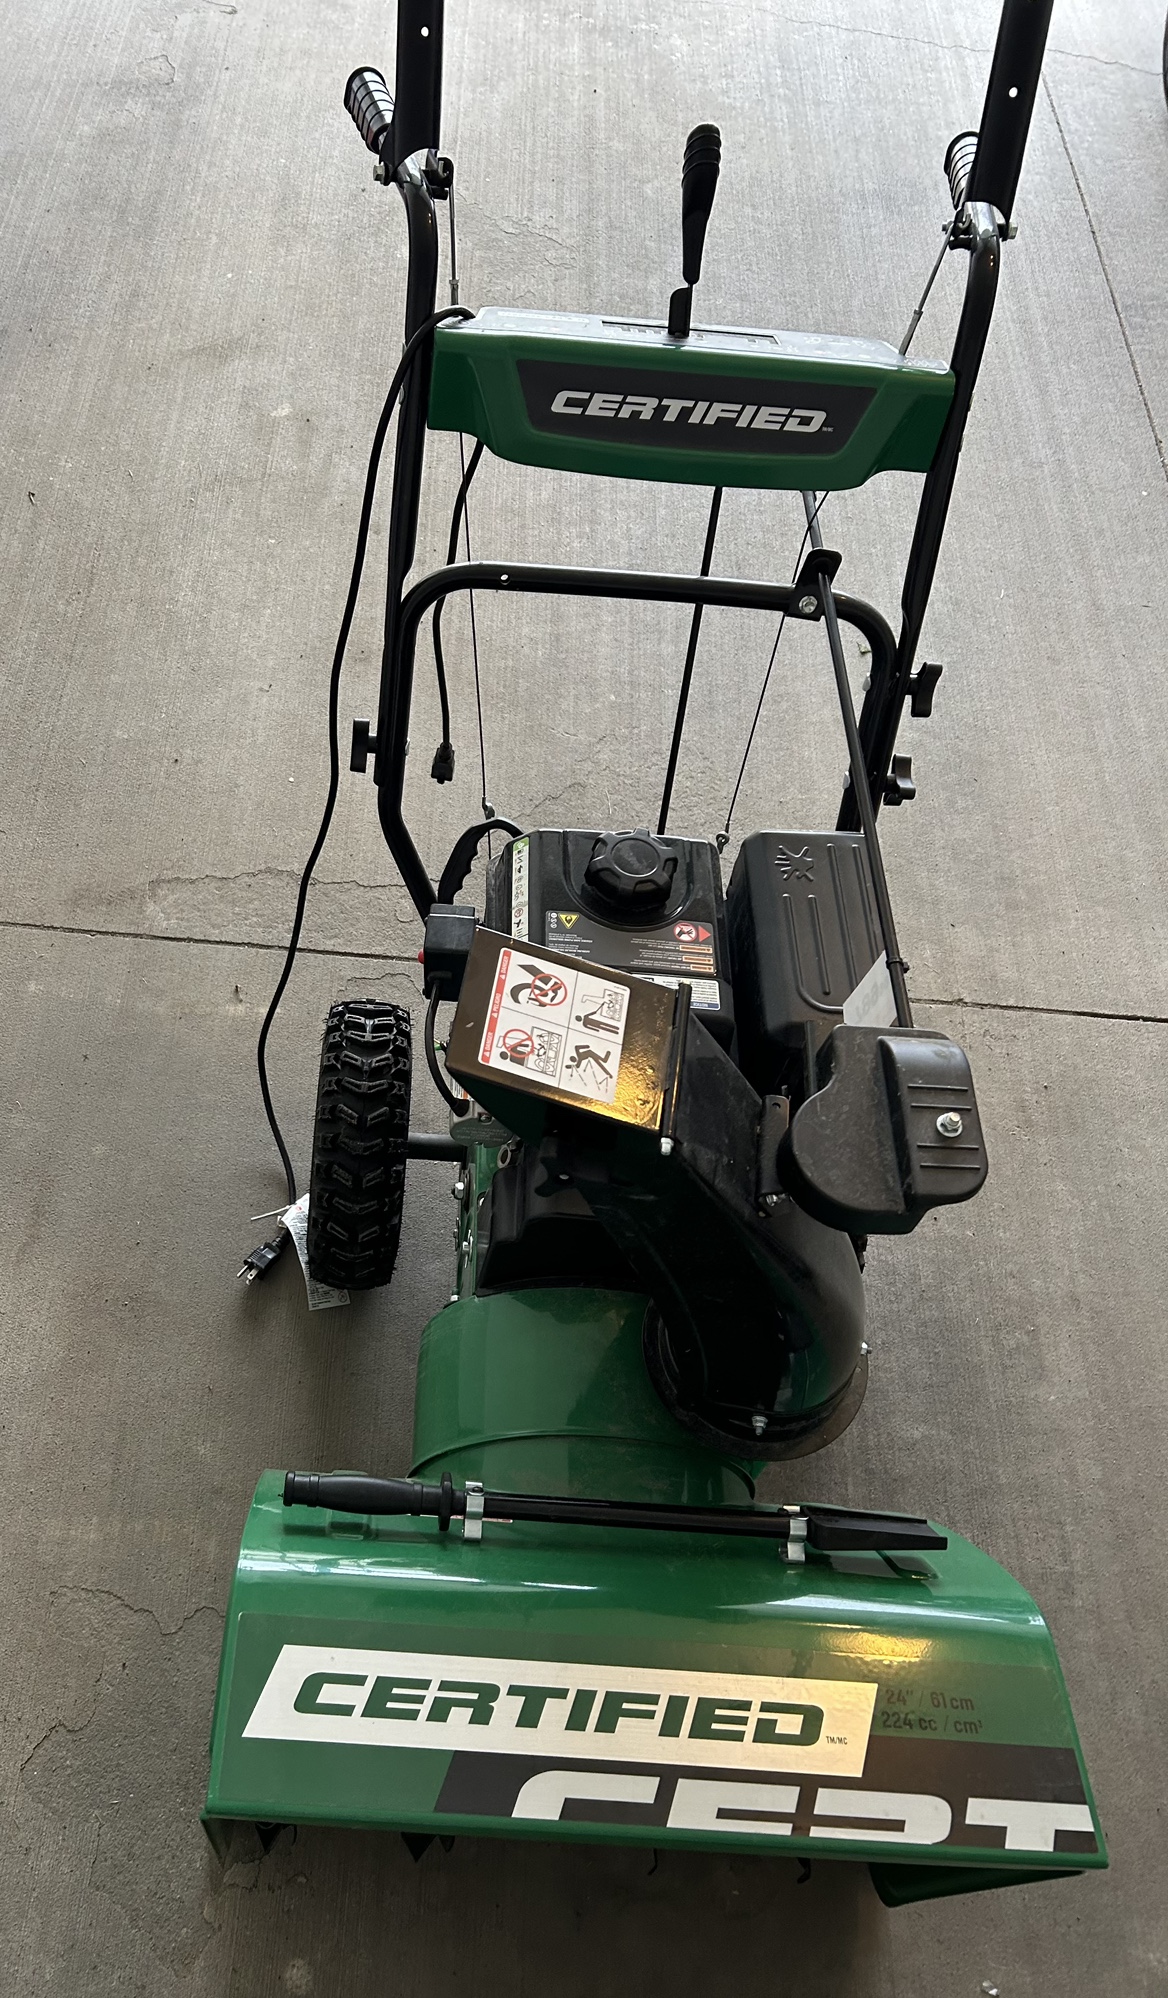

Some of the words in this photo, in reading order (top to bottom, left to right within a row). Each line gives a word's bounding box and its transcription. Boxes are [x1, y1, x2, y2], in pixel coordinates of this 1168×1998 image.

[550, 389, 828, 434] CERTIFIED
[499, 955, 509, 974] DANGER
[485, 1031, 494, 1051] DANGER
[293, 1671, 825, 1747] CERTIFIED
[881, 1710, 914, 1730] 224
[918, 1718, 938, 1731] cc
[825, 1735, 848, 1745] TM/MC
